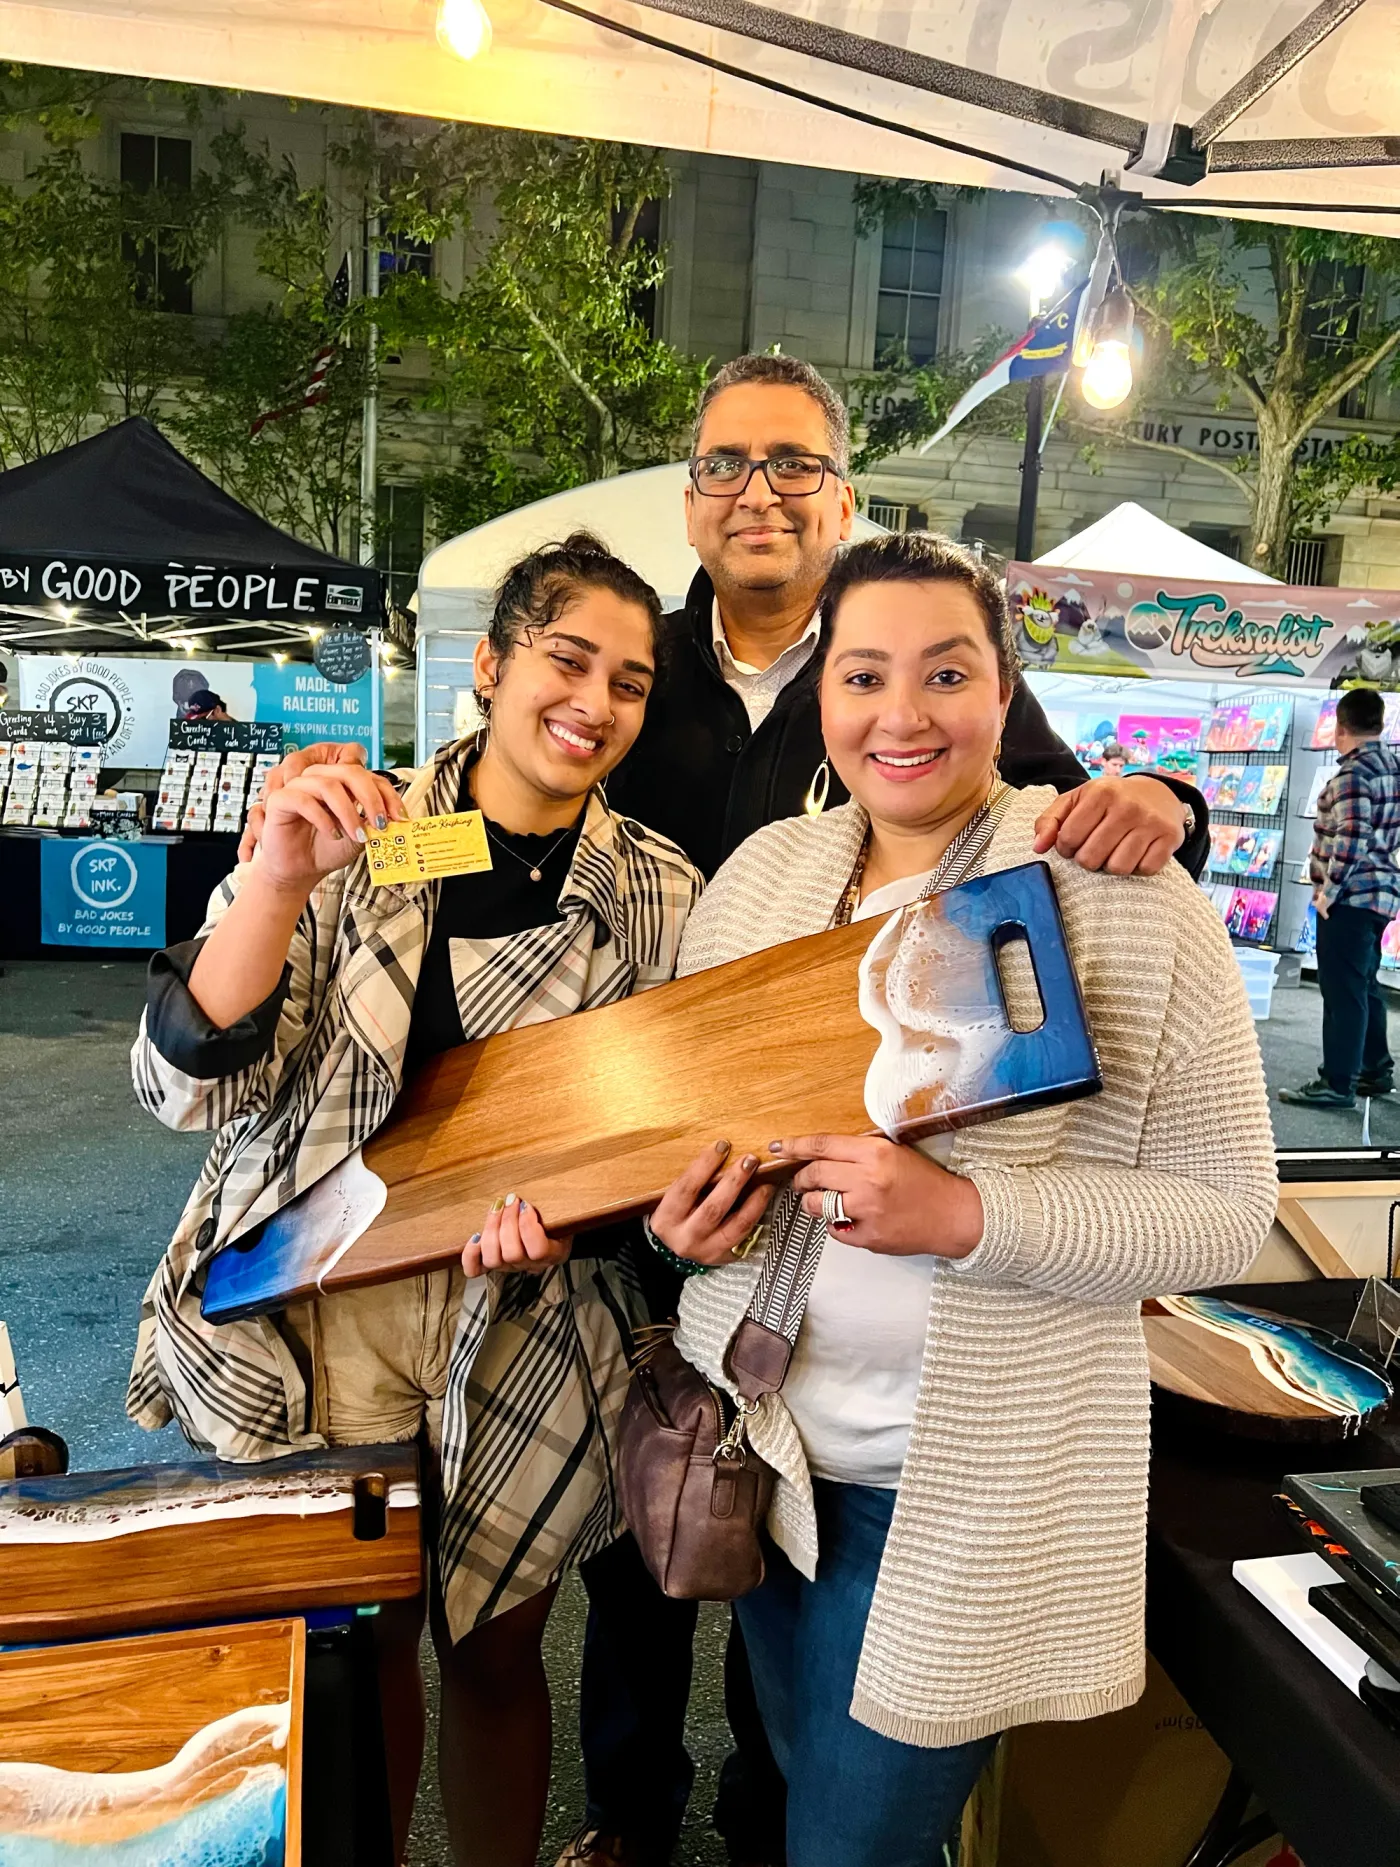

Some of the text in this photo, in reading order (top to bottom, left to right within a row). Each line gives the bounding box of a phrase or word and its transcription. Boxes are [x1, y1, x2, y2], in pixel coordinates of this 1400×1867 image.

[861, 394, 909, 415] FED
[1126, 420, 1183, 444] TURY
[1297, 437, 1388, 461] STATON
[0, 560, 319, 612] BY GOOD PEOPLE
[1156, 591, 1334, 658] Treksalot
[35, 660, 135, 704] BAD JOKES BY GOOD PEOPLE
[295, 676, 331, 693] MADE
[66, 694, 99, 712] SKP
[283, 695, 360, 715] RALEIGH, NC
[0, 712, 32, 727] Greeting
[68, 713, 101, 726] Buy 3
[6, 726, 28, 737] Cards
[70, 727, 82, 740] get
[108, 716, 135, 756] AND GIFTS
[181, 721, 211, 736] Greeting
[250, 723, 279, 738] Buy 3
[282, 722, 373, 737] W.SKPINK.ETSY.CO
[187, 735, 208, 746] Cards
[225, 739, 239, 747] each
[89, 858, 117, 873] SKP
[91, 878, 122, 894] INK.
[75, 909, 134, 922] BAD JOKES
[58, 922, 151, 936] BY GOOD PEOPLE
